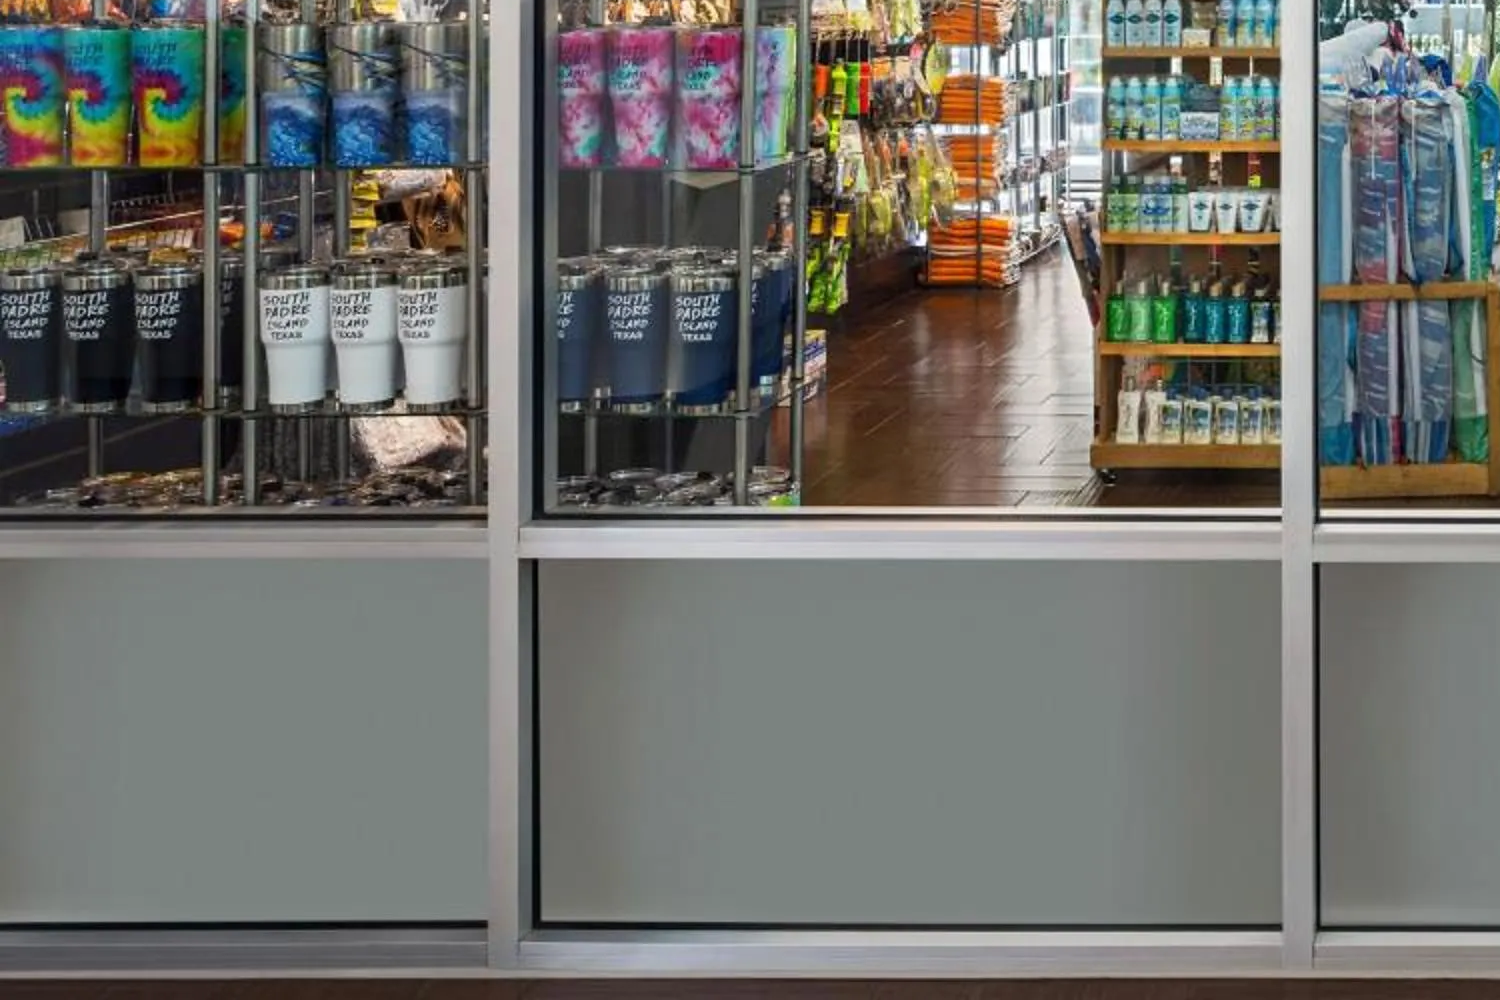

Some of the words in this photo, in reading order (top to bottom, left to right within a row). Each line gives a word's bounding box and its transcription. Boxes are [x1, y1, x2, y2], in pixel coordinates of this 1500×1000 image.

[0, 291, 49, 305] SOUTH
[63, 291, 107, 305] SOUTH
[134, 291, 179, 305] SOUTH
[264, 292, 309, 305] SOUTH
[331, 292, 371, 305] SOUTH
[608, 292, 651, 306] SOUTH
[675, 293, 720, 307] SOUTH
[1, 303, 51, 317] PADRE
[63, 303, 109, 317] PADRE
[135, 303, 180, 318] PADRE
[265, 304, 311, 318] PADRE
[331, 304, 372, 318] PADRE
[608, 304, 652, 318] PADRE
[676, 306, 720, 319] PADRE
[4, 317, 48, 329] ISLAND
[268, 318, 309, 329] ISLAND
[610, 319, 648, 330] ISLAND
[680, 320, 717, 332] ISLAND
[8, 330, 42, 339] TEXAS
[68, 331, 99, 340] TEXAS
[141, 330, 172, 340] TEXAS
[271, 331, 303, 340] TEXAS
[613, 331, 643, 340] TEXAS
[682, 333, 712, 341] TEXAS
